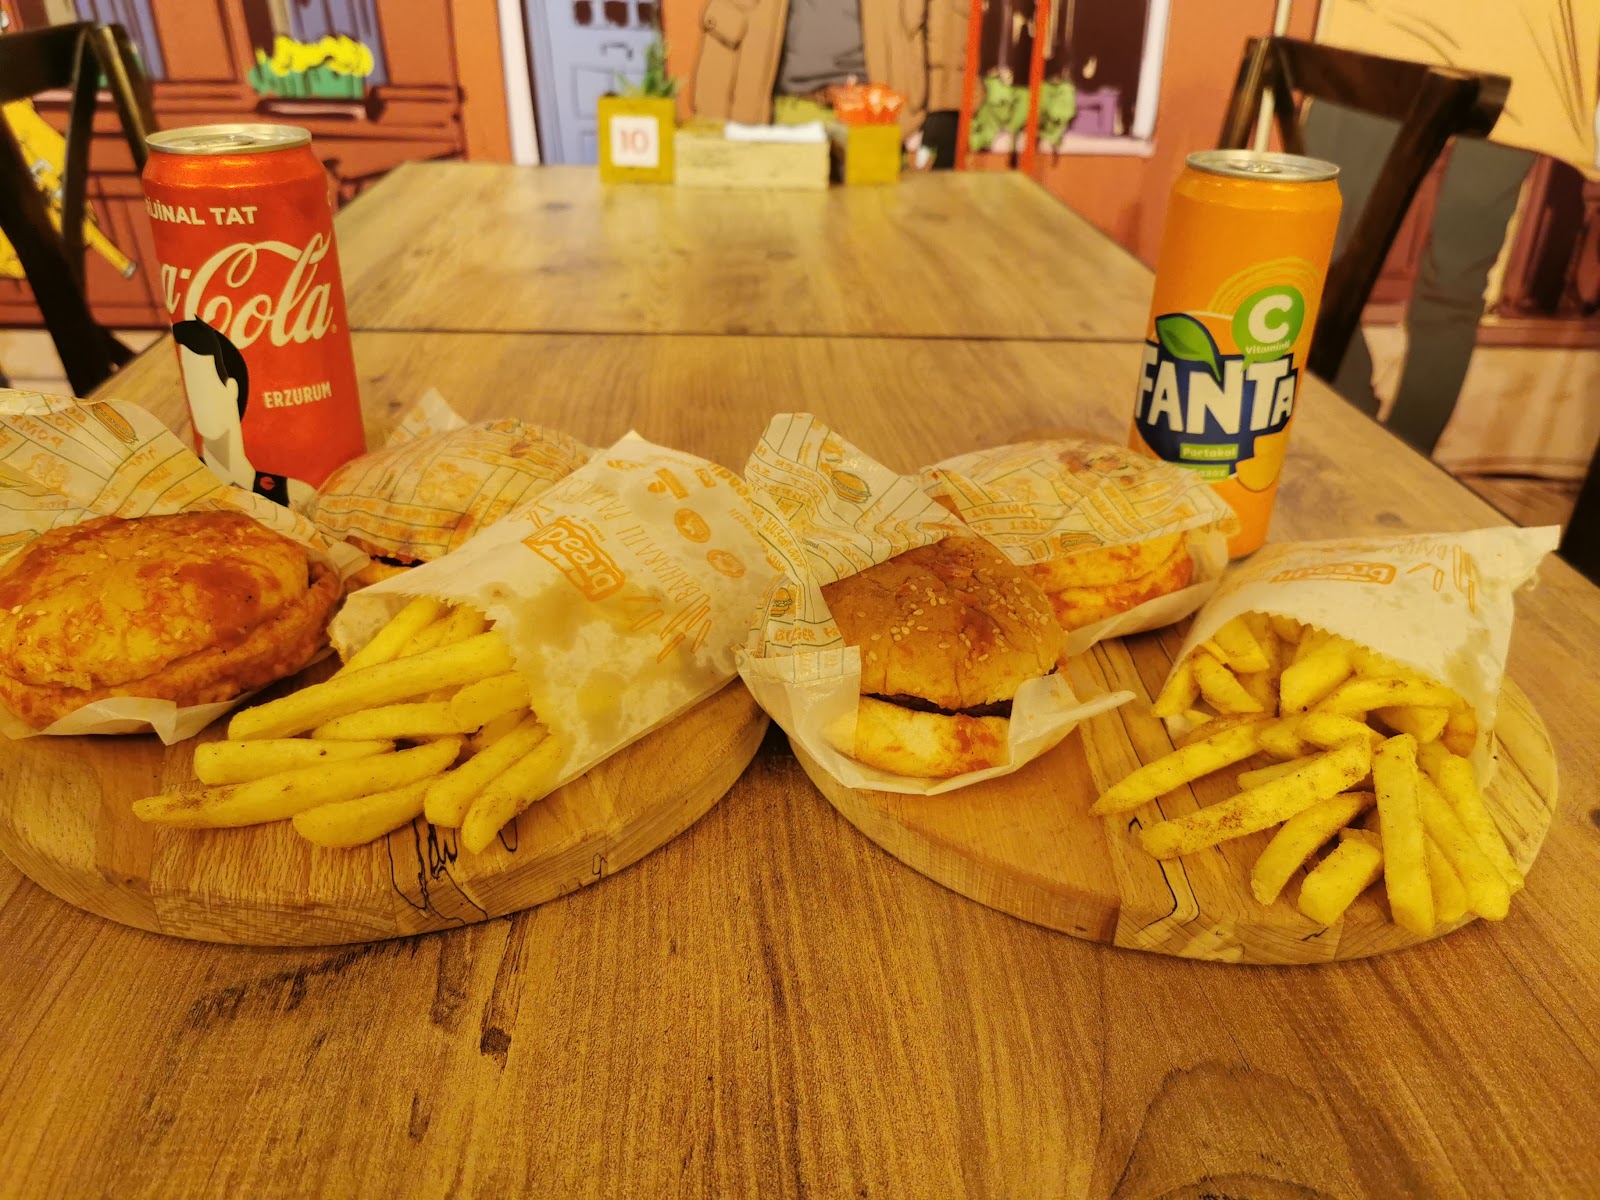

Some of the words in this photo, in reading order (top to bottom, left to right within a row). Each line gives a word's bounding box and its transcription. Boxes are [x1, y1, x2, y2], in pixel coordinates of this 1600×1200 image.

[619, 128, 649, 154] 10
[210, 206, 258, 225] TAT
[1248, 294, 1293, 344] C
[263, 382, 332, 409] ERZURUM
[1135, 344, 1296, 434] FANTA
